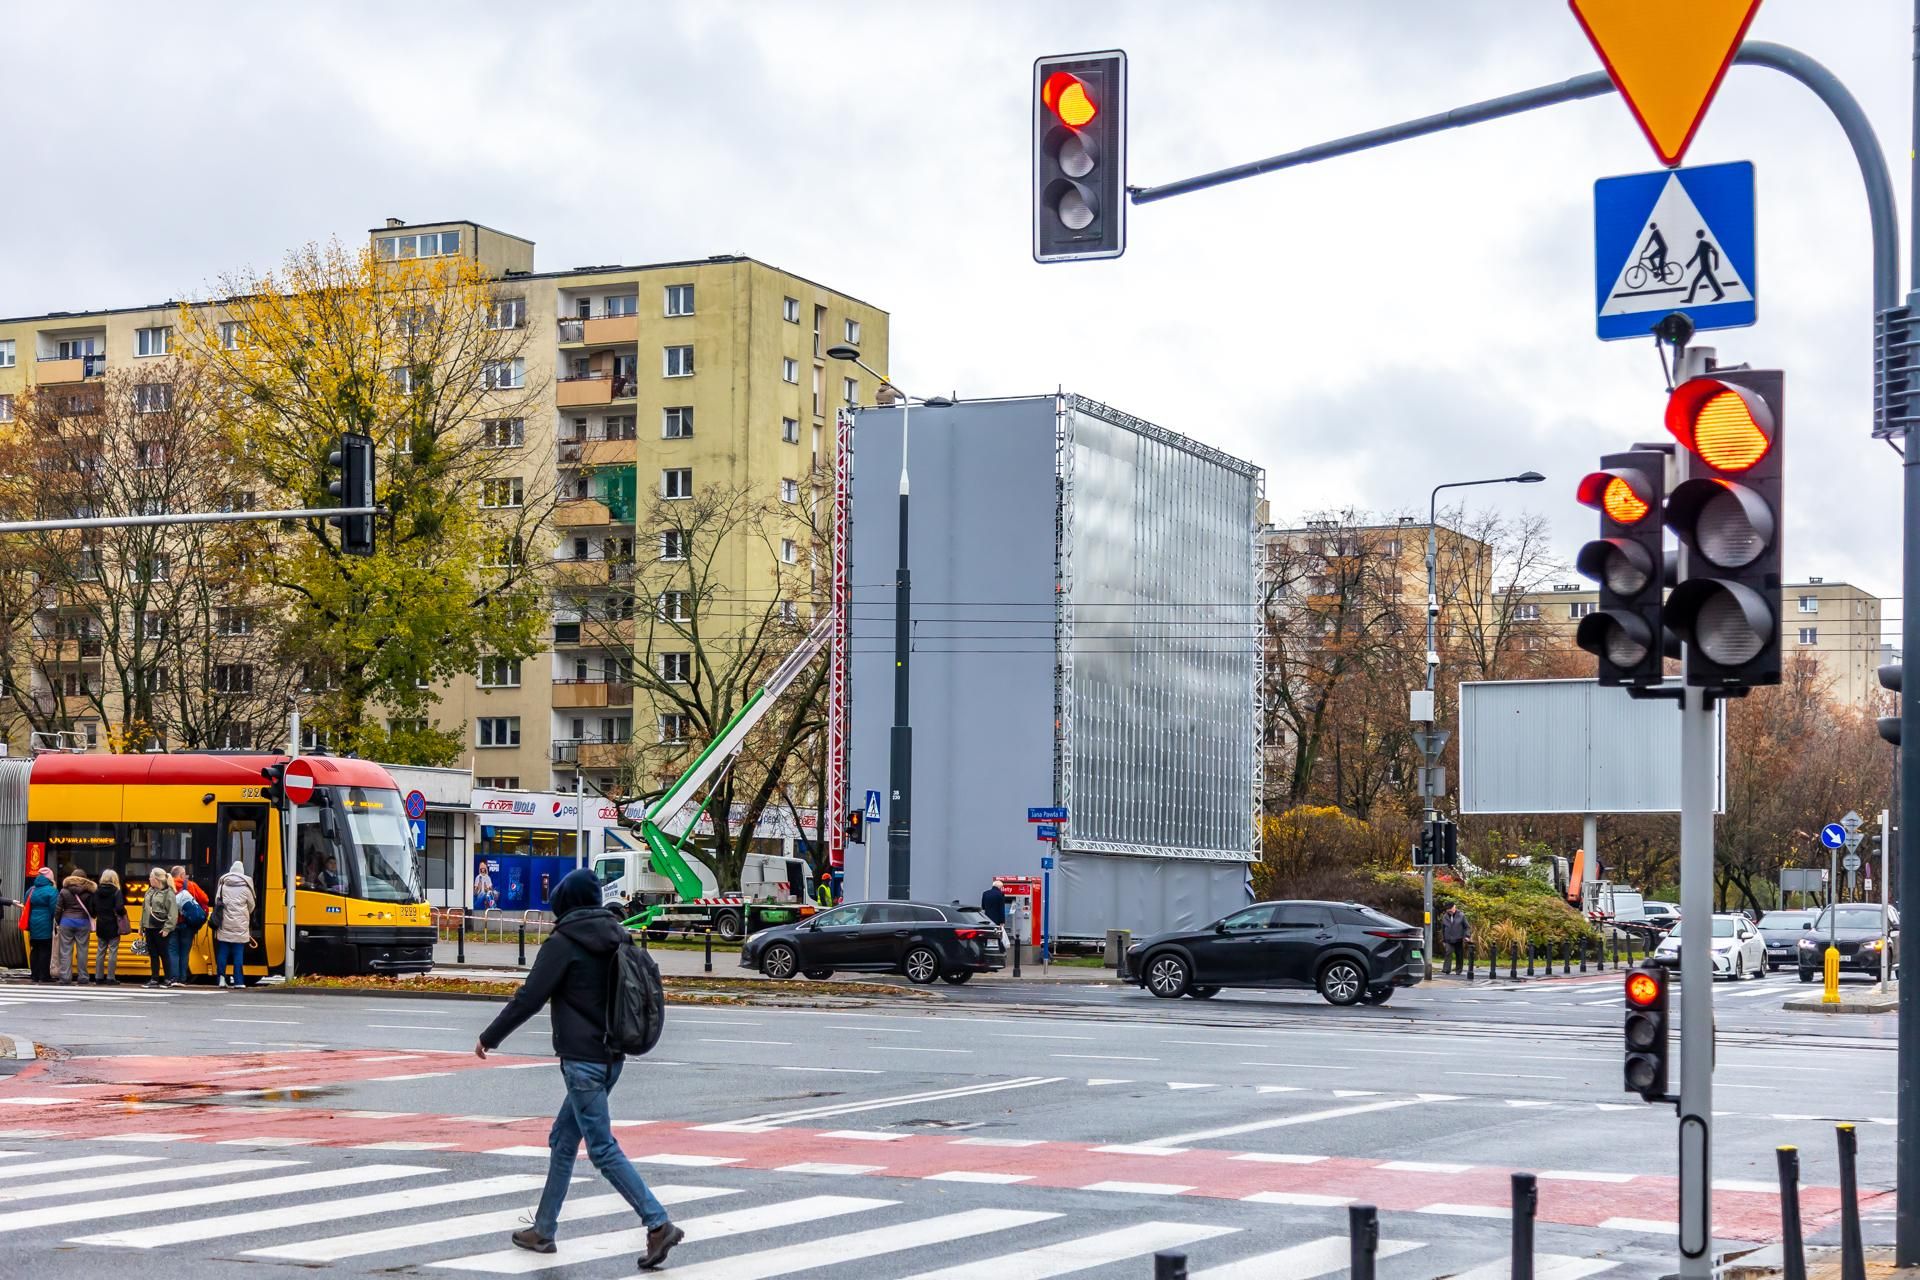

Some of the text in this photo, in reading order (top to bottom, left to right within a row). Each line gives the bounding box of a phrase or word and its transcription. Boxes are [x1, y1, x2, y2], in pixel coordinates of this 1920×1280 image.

[241, 787, 261, 798] 322
[513, 800, 536, 813] WOLA
[563, 805, 579, 817] pep
